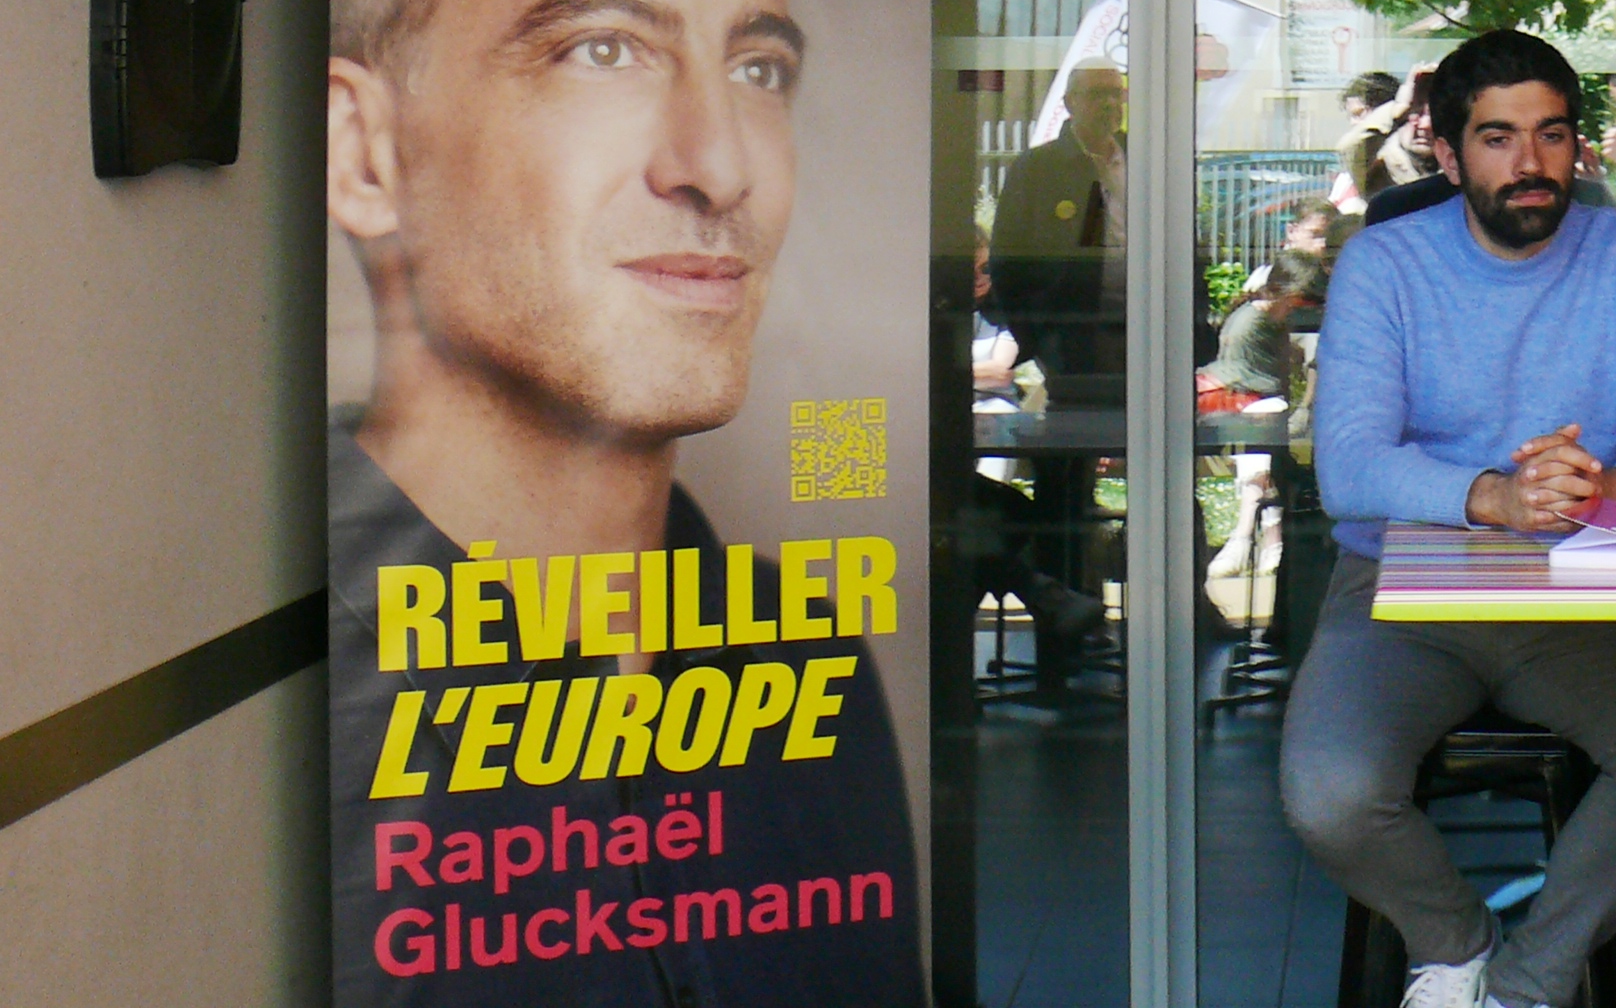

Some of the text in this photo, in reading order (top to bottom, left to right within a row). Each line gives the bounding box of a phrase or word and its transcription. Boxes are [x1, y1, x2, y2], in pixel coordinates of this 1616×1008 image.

[376, 536, 899, 672] RÉVEILLER
[367, 656, 858, 801] L'EUROPE
[373, 790, 724, 894] Raphaël
[373, 870, 895, 978] Glucksmann
